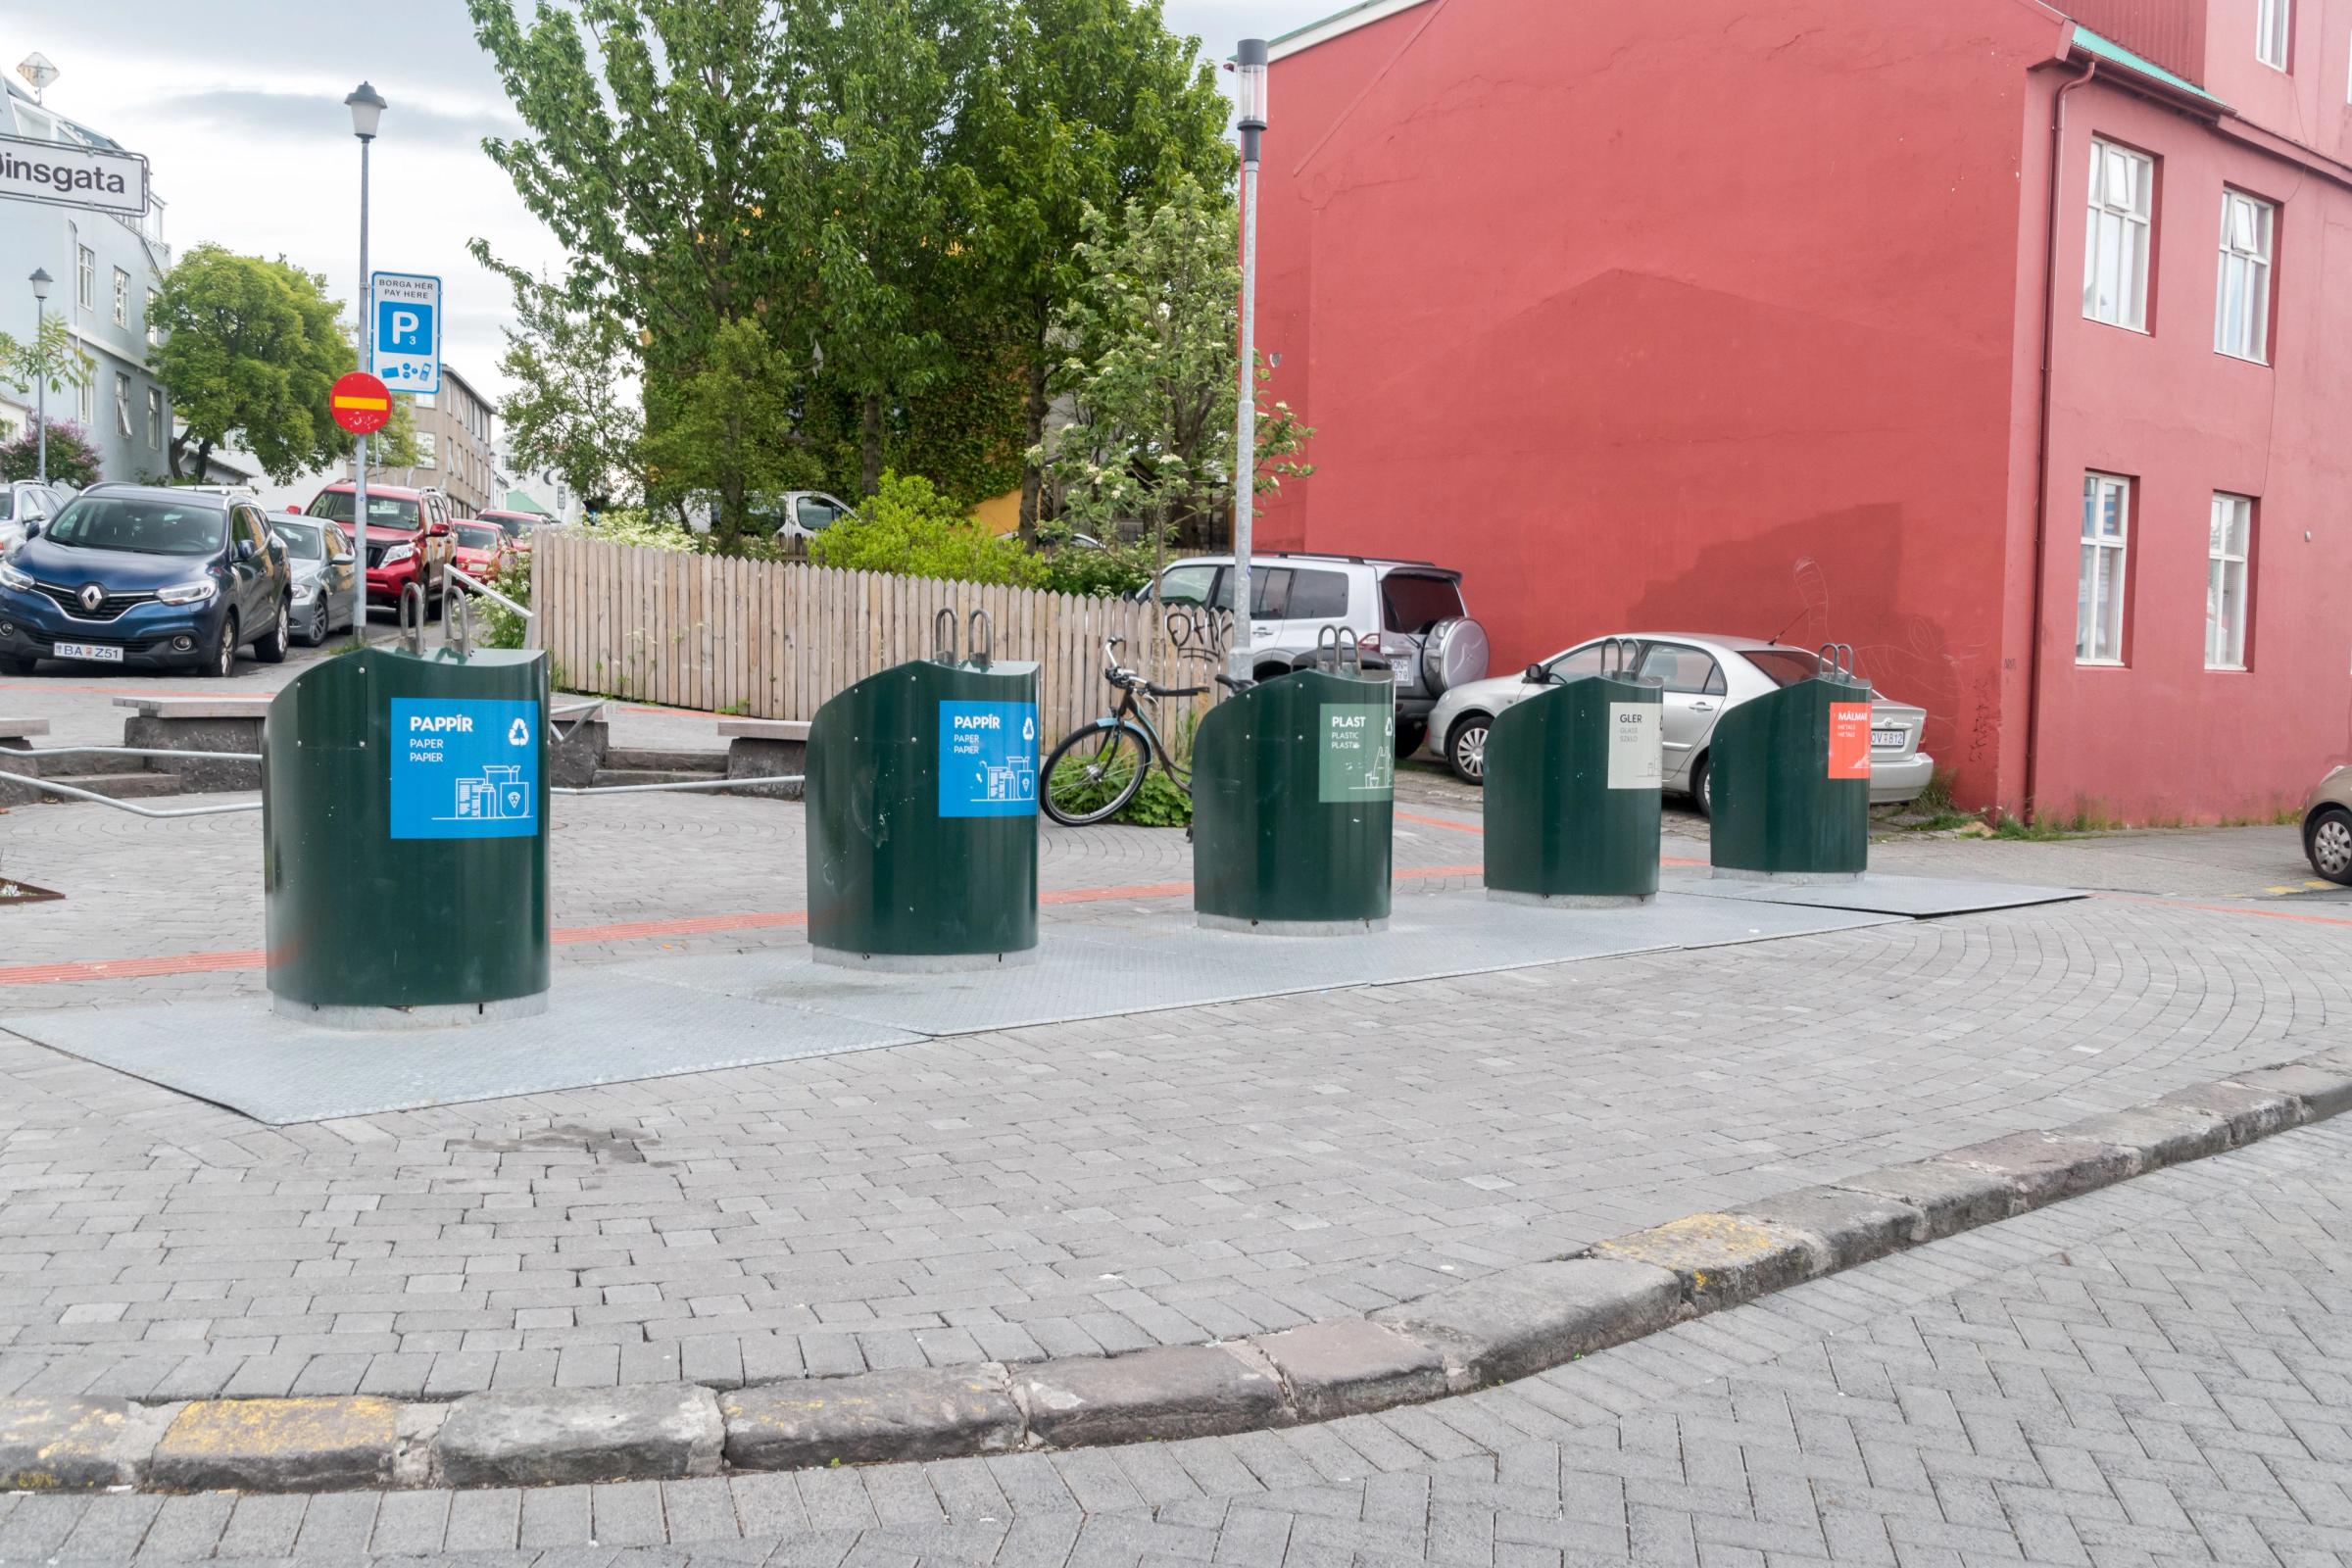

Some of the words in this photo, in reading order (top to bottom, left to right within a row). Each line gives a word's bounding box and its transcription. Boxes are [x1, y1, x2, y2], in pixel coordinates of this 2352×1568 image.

[0, 152, 124, 194] insgata
[379, 279, 412, 288] BORGA
[393, 311, 418, 344] P
[409, 336, 416, 345] 3
[64, 645, 82, 656] BA
[95, 648, 119, 659] Z51
[410, 714, 473, 732] PAPPÍR
[955, 713, 1001, 729] PAPPÍR
[1332, 715, 1366, 728] PLAST
[1620, 714, 1642, 723] GLER
[410, 739, 444, 749] PAPER
[954, 734, 979, 743] PAPER
[1889, 733, 1903, 744] 812
[410, 752, 444, 762] PAPIER
